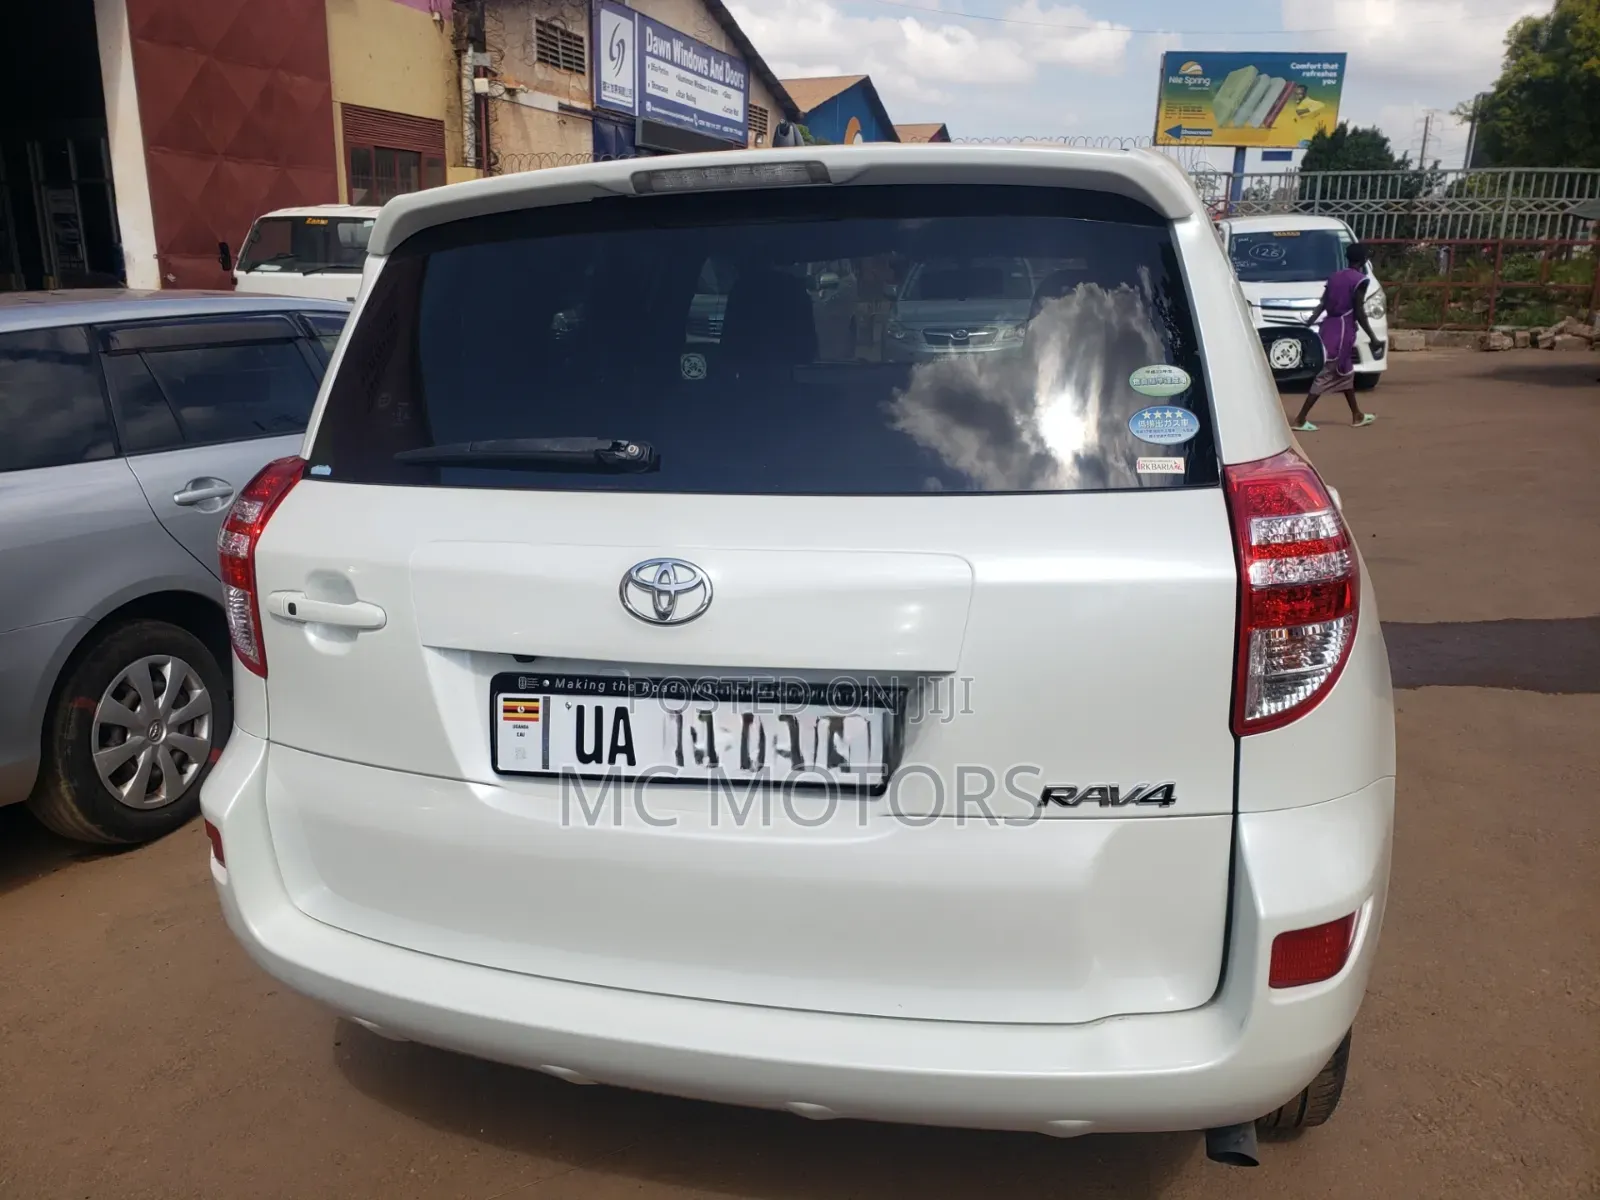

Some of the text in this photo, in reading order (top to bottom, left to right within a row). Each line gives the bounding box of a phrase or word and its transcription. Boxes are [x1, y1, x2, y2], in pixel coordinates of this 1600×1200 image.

[646, 26, 671, 61] Dawn
[672, 38, 709, 75] Windows
[710, 56, 724, 82] And
[724, 62, 745, 90] Doors
[1290, 62, 1339, 70] Comfort that
[1168, 76, 1211, 87] Nile Spring
[1322, 79, 1337, 87] you
[554, 678, 606, 693] Making
[612, 680, 635, 692] the
[1038, 781, 1178, 809] RAV4
